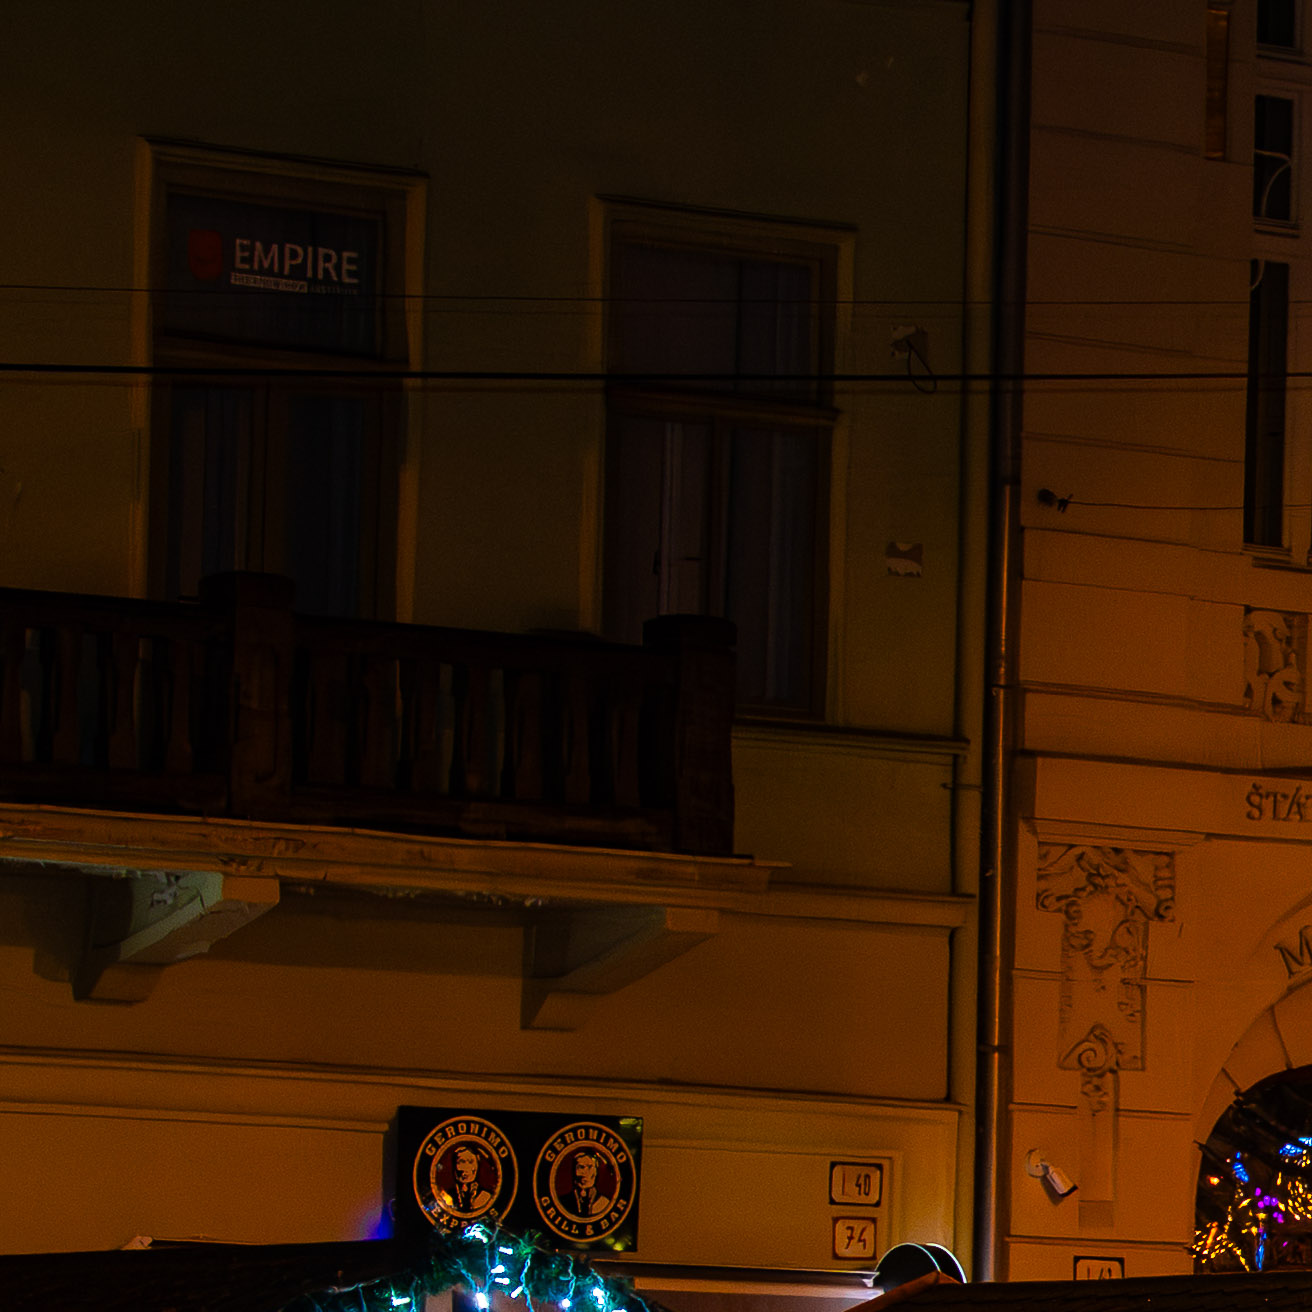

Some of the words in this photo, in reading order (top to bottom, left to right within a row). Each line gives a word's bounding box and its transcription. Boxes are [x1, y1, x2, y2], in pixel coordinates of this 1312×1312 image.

[234, 237, 360, 284] EMPIRE
[425, 1122, 509, 1158] GERONIMO
[544, 1128, 628, 1164] GERONIMO
[855, 1173, 871, 1197] 40
[431, 1206, 499, 1231] EXPRS
[541, 1196, 579, 1235] GRILL
[585, 1223, 596, 1237] &
[601, 1198, 628, 1231] BAR
[845, 1225, 868, 1251] 74
